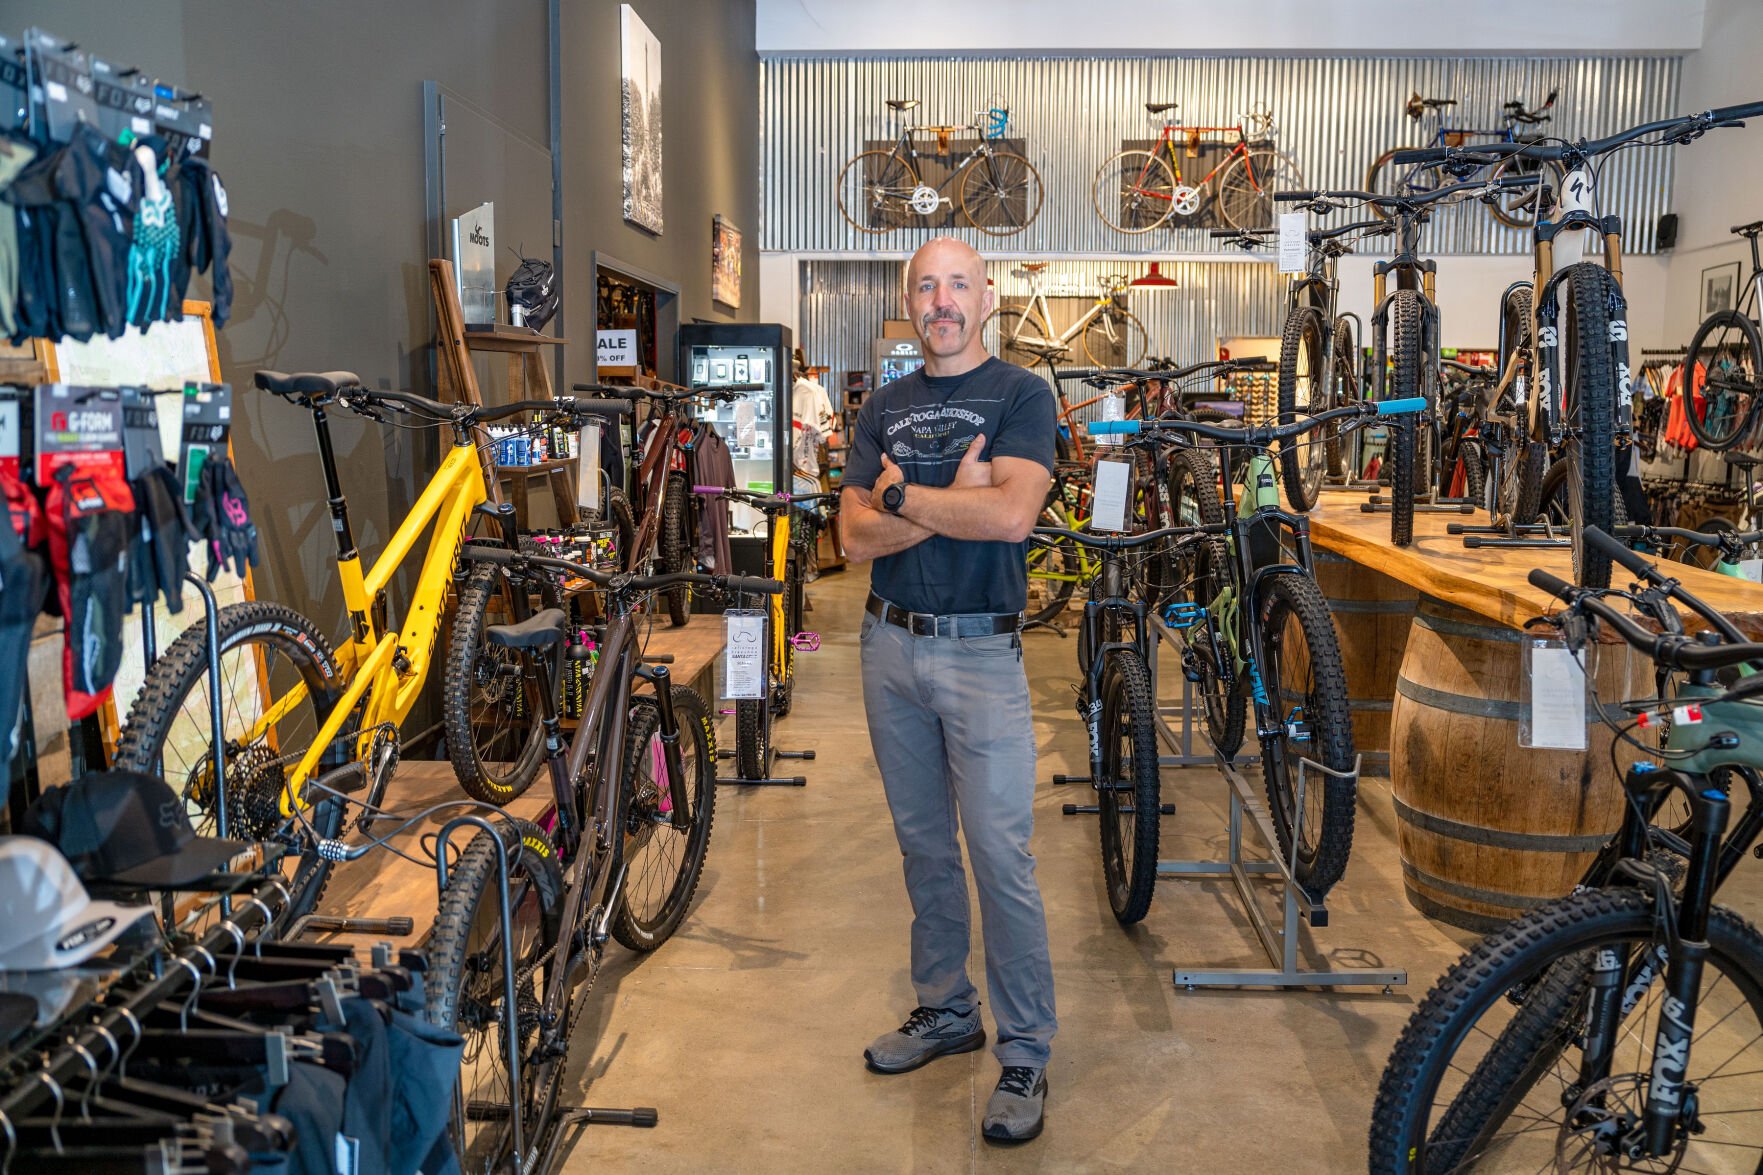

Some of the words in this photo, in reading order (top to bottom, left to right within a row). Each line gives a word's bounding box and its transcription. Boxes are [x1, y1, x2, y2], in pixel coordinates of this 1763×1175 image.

[97, 84, 136, 111] FOX
[469, 232, 490, 247] MOOTS
[598, 337, 627, 349] ALE
[68, 411, 113, 432] G-FORM
[701, 716, 714, 763] MAXXIS
[1649, 1031, 1691, 1106] FOX
